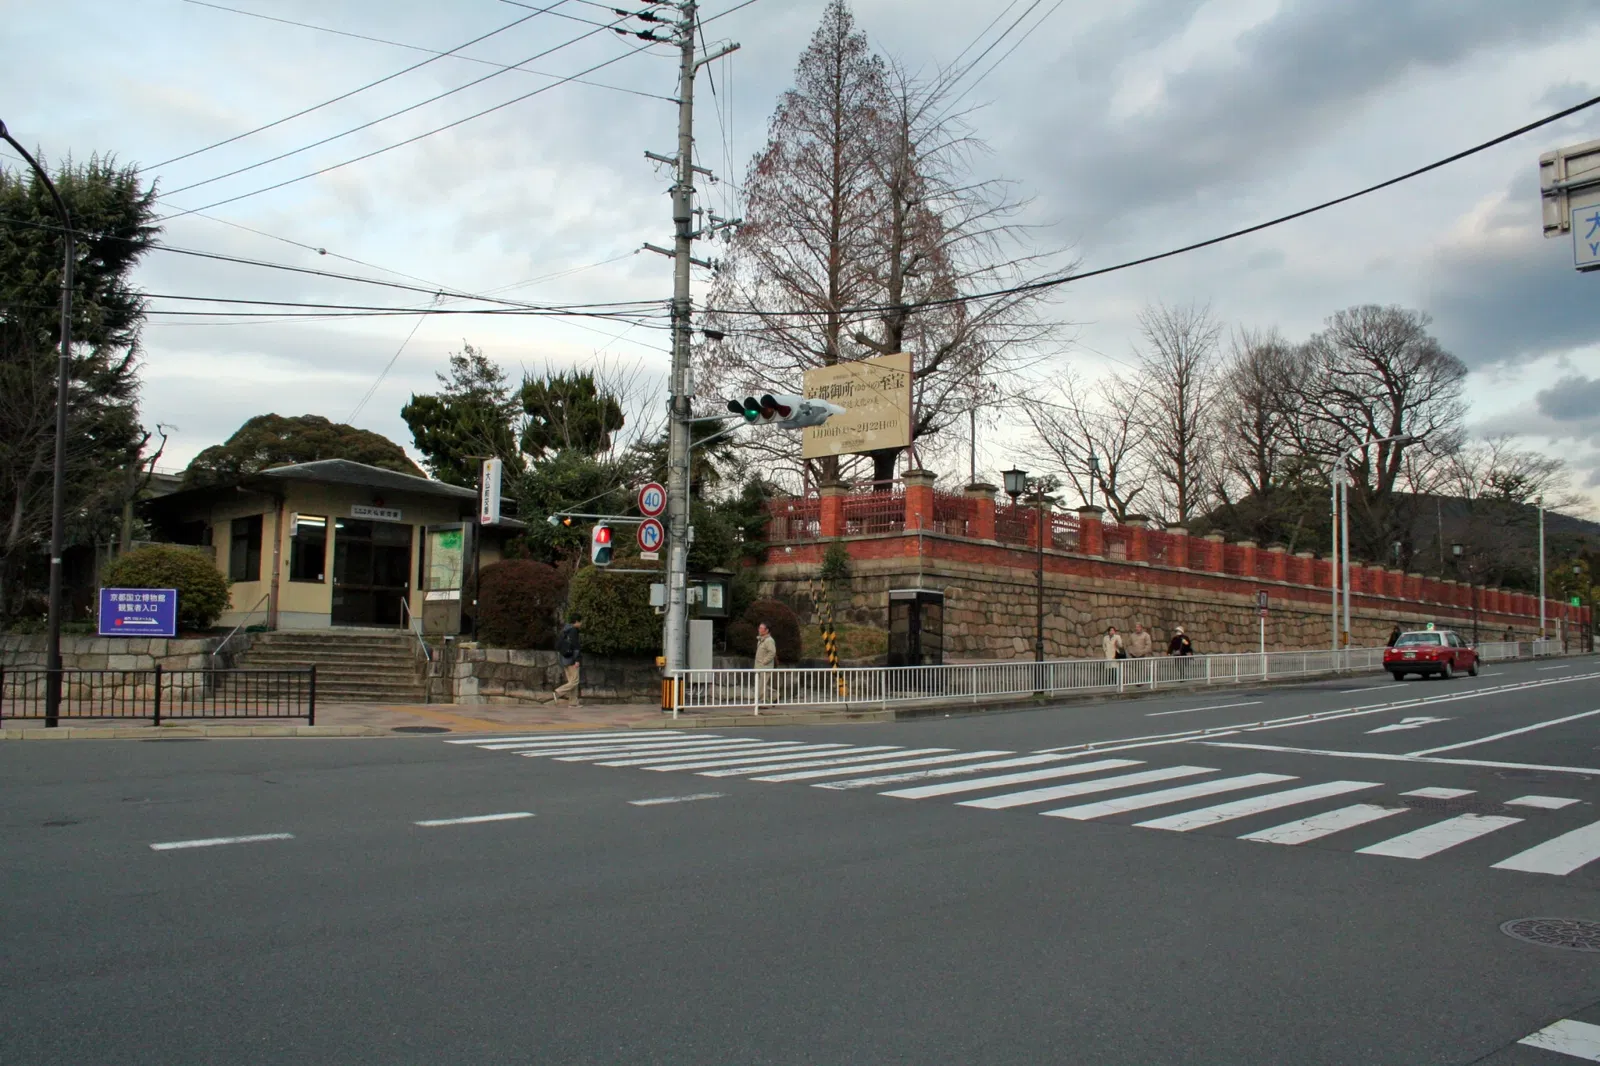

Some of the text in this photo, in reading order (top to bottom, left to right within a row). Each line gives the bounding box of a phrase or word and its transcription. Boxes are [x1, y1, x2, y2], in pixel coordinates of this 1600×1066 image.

[644, 492, 660, 507] 40
[110, 593, 166, 603] 京都国立博物館
[118, 603, 158, 612] 観覧者入口
